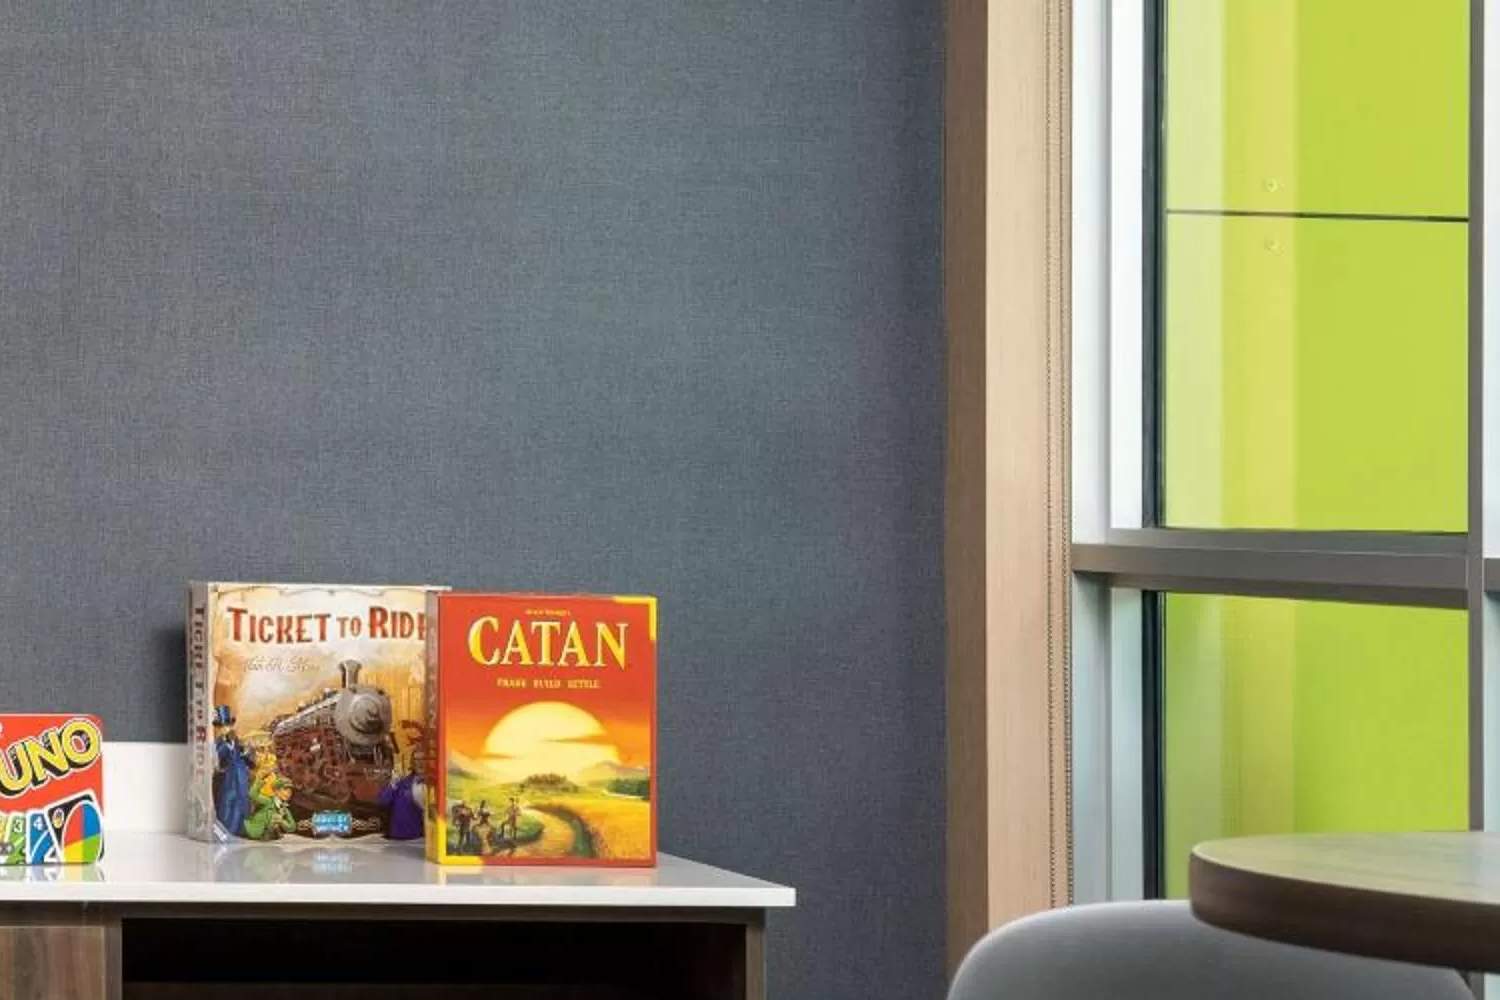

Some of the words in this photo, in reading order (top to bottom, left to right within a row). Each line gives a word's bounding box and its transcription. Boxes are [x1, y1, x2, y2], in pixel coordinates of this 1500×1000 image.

[227, 606, 331, 644] TICKET
[336, 616, 362, 638] TO
[468, 615, 628, 669] CATAN
